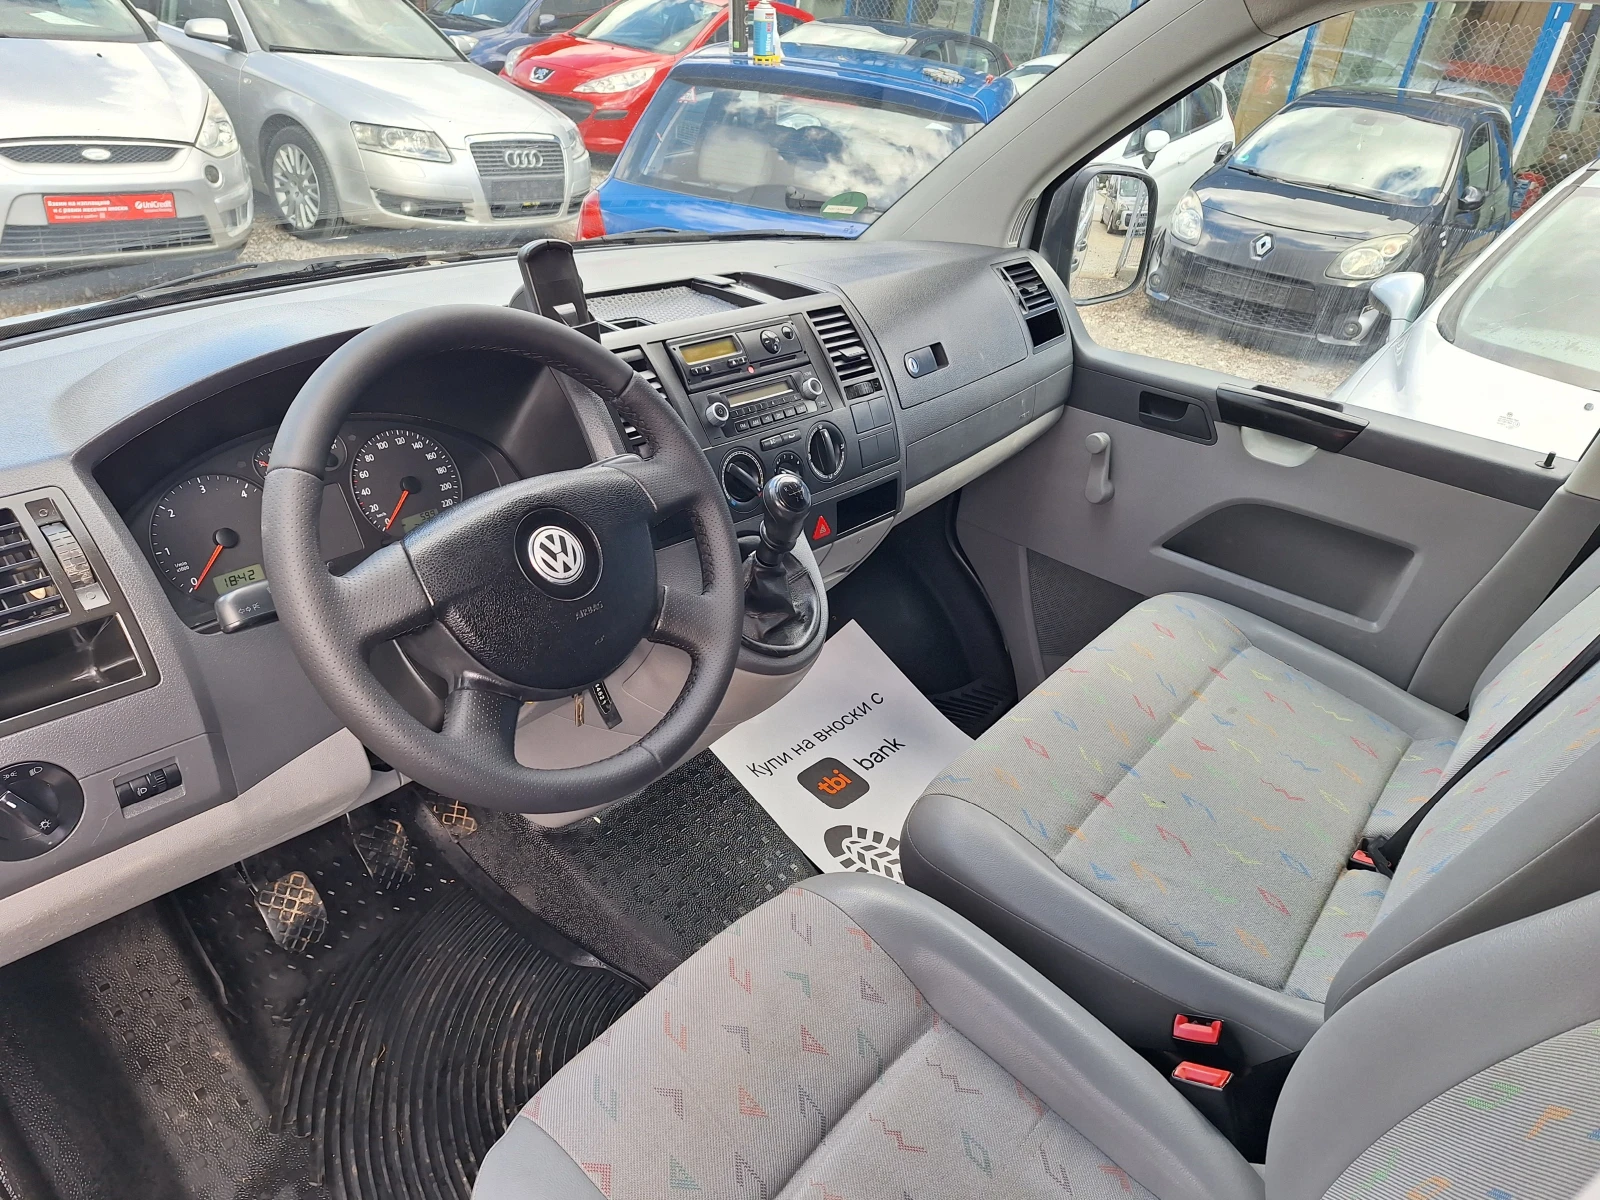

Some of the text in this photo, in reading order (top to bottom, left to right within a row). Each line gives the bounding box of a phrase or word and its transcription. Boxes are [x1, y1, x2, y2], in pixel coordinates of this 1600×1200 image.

[142, 200, 172, 209] UniCredit
[376, 440, 389, 450] 100
[394, 436, 406, 446] 120
[411, 441, 424, 450] 140
[364, 453, 375, 463] 80
[425, 451, 437, 461] 160
[359, 469, 370, 479] 60
[435, 465, 448, 475] 180
[199, 484, 207, 494] 3
[439, 481, 453, 491] 200
[240, 489, 248, 498] 4
[360, 487, 371, 496] 40
[369, 503, 380, 513] 20
[440, 498, 454, 508] 220
[167, 508, 176, 518] 2
[384, 517, 391, 526] 0
[164, 546, 171, 556] 1
[190, 577, 198, 586] 0
[224, 569, 256, 588] 18:42
[575, 601, 604, 621] AIRBAG
[745, 692, 884, 778] Купи на вноски с
[817, 737, 907, 795] tbi bank
